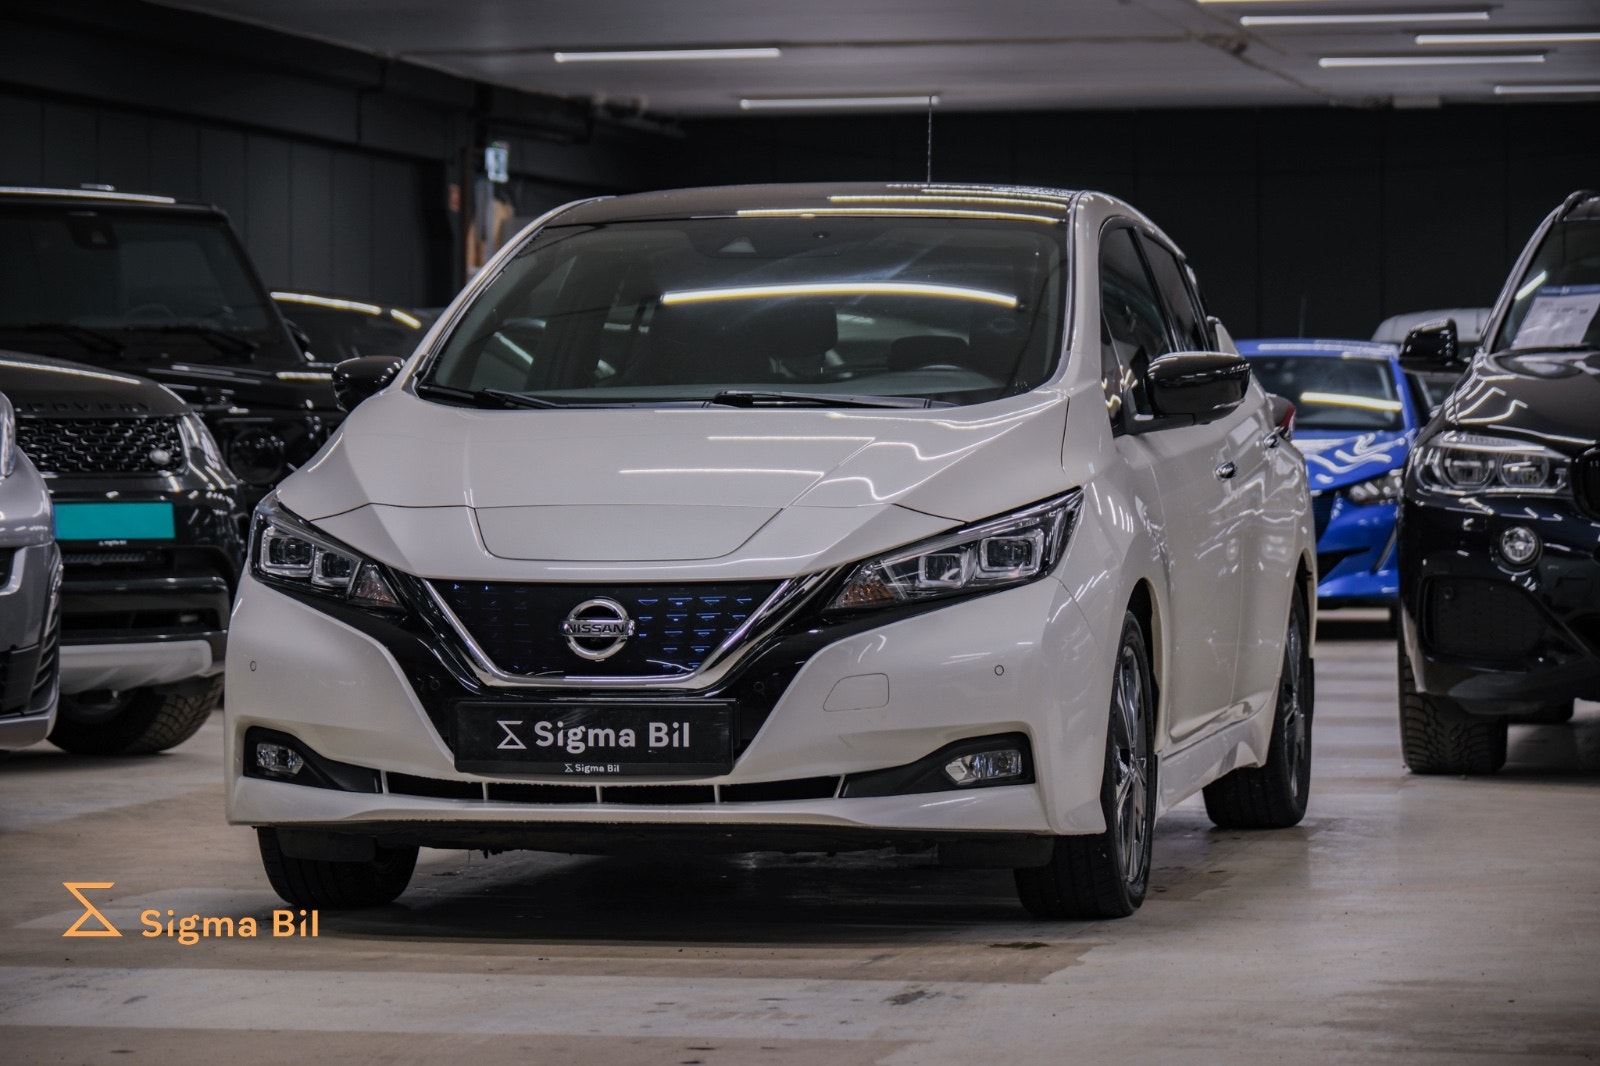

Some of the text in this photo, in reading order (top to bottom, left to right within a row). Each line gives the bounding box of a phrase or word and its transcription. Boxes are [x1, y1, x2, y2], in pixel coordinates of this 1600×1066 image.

[566, 623, 625, 634] NISSAN
[534, 720, 690, 754] Sigma Bil
[574, 763, 620, 774] Sigma Bil
